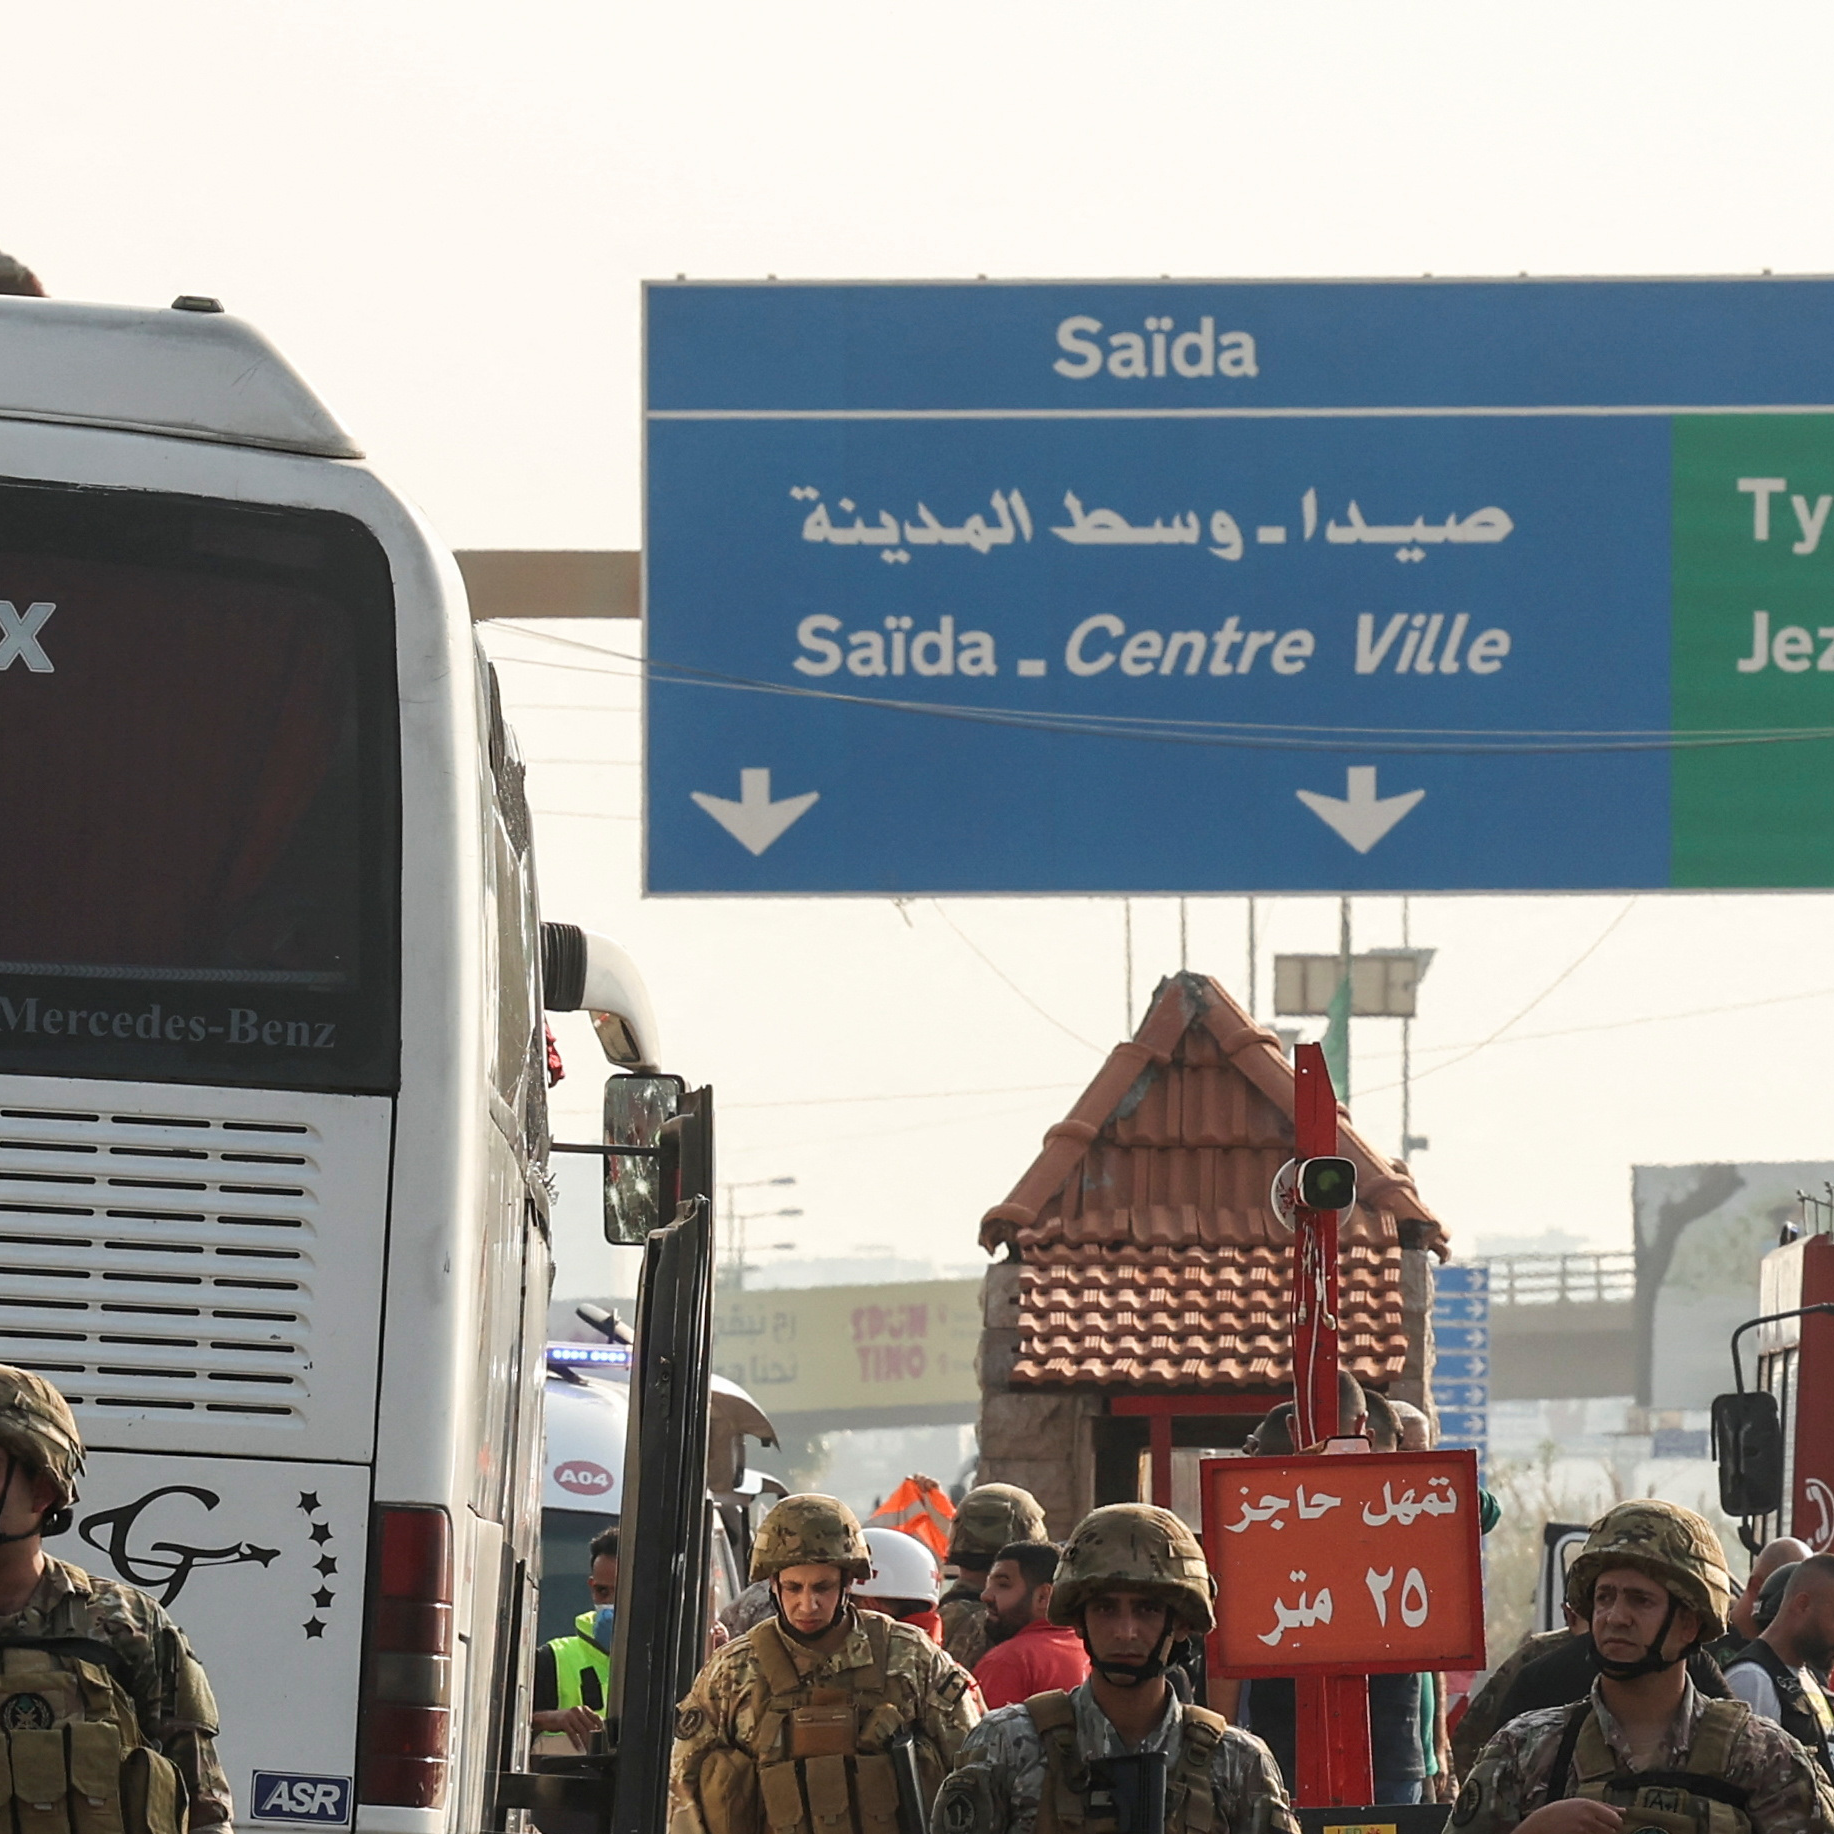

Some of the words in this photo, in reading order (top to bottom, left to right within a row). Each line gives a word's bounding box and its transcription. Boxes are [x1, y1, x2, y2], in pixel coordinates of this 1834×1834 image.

[1052, 315, 1259, 379] Saïda
[789, 485, 1033, 564] المدينة
[1050, 490, 1244, 561] وسط
[1302, 487, 1514, 563] صيدا
[793, 614, 998, 677] Saïda
[1065, 613, 1315, 677] Centre
[1354, 612, 1511, 675] Ville
[559, 1469, 609, 1487] A04
[1224, 1485, 1342, 1533] حاجز
[1362, 1476, 1457, 1527] تمهل
[1257, 1569, 1333, 1647] متر
[1365, 1566, 1428, 1628] ٢٥
[262, 1781, 340, 1815] ASR
